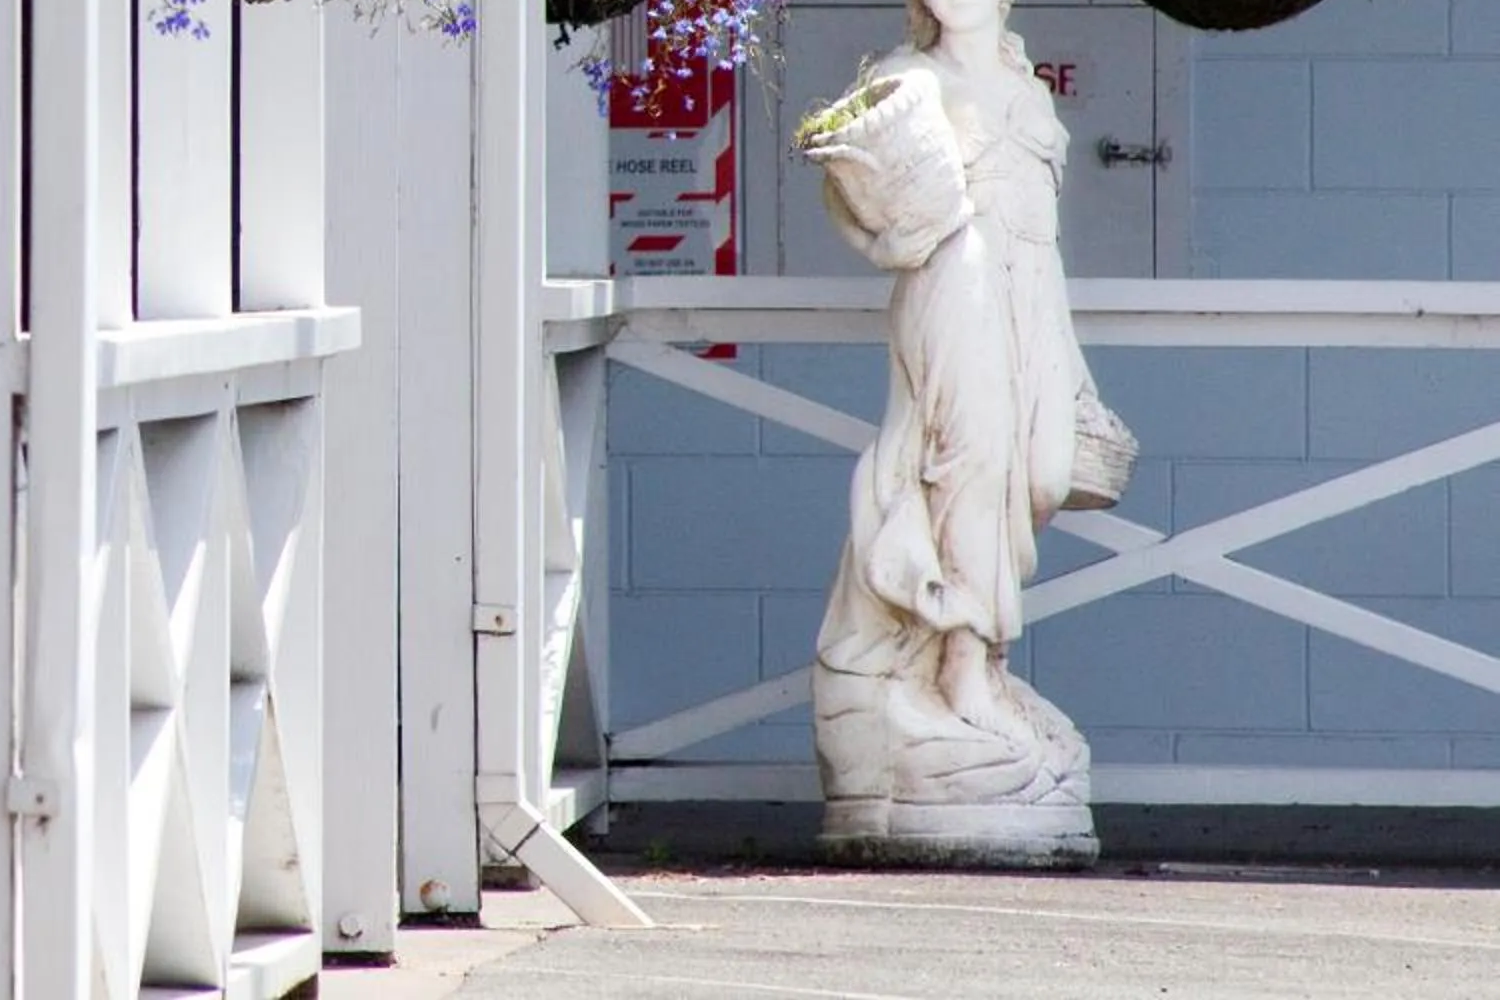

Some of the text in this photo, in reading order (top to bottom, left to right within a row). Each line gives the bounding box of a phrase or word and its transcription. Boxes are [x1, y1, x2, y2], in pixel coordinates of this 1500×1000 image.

[1034, 63, 1077, 96] SE
[616, 158, 657, 174] HOSE
[659, 158, 698, 174] REEL
